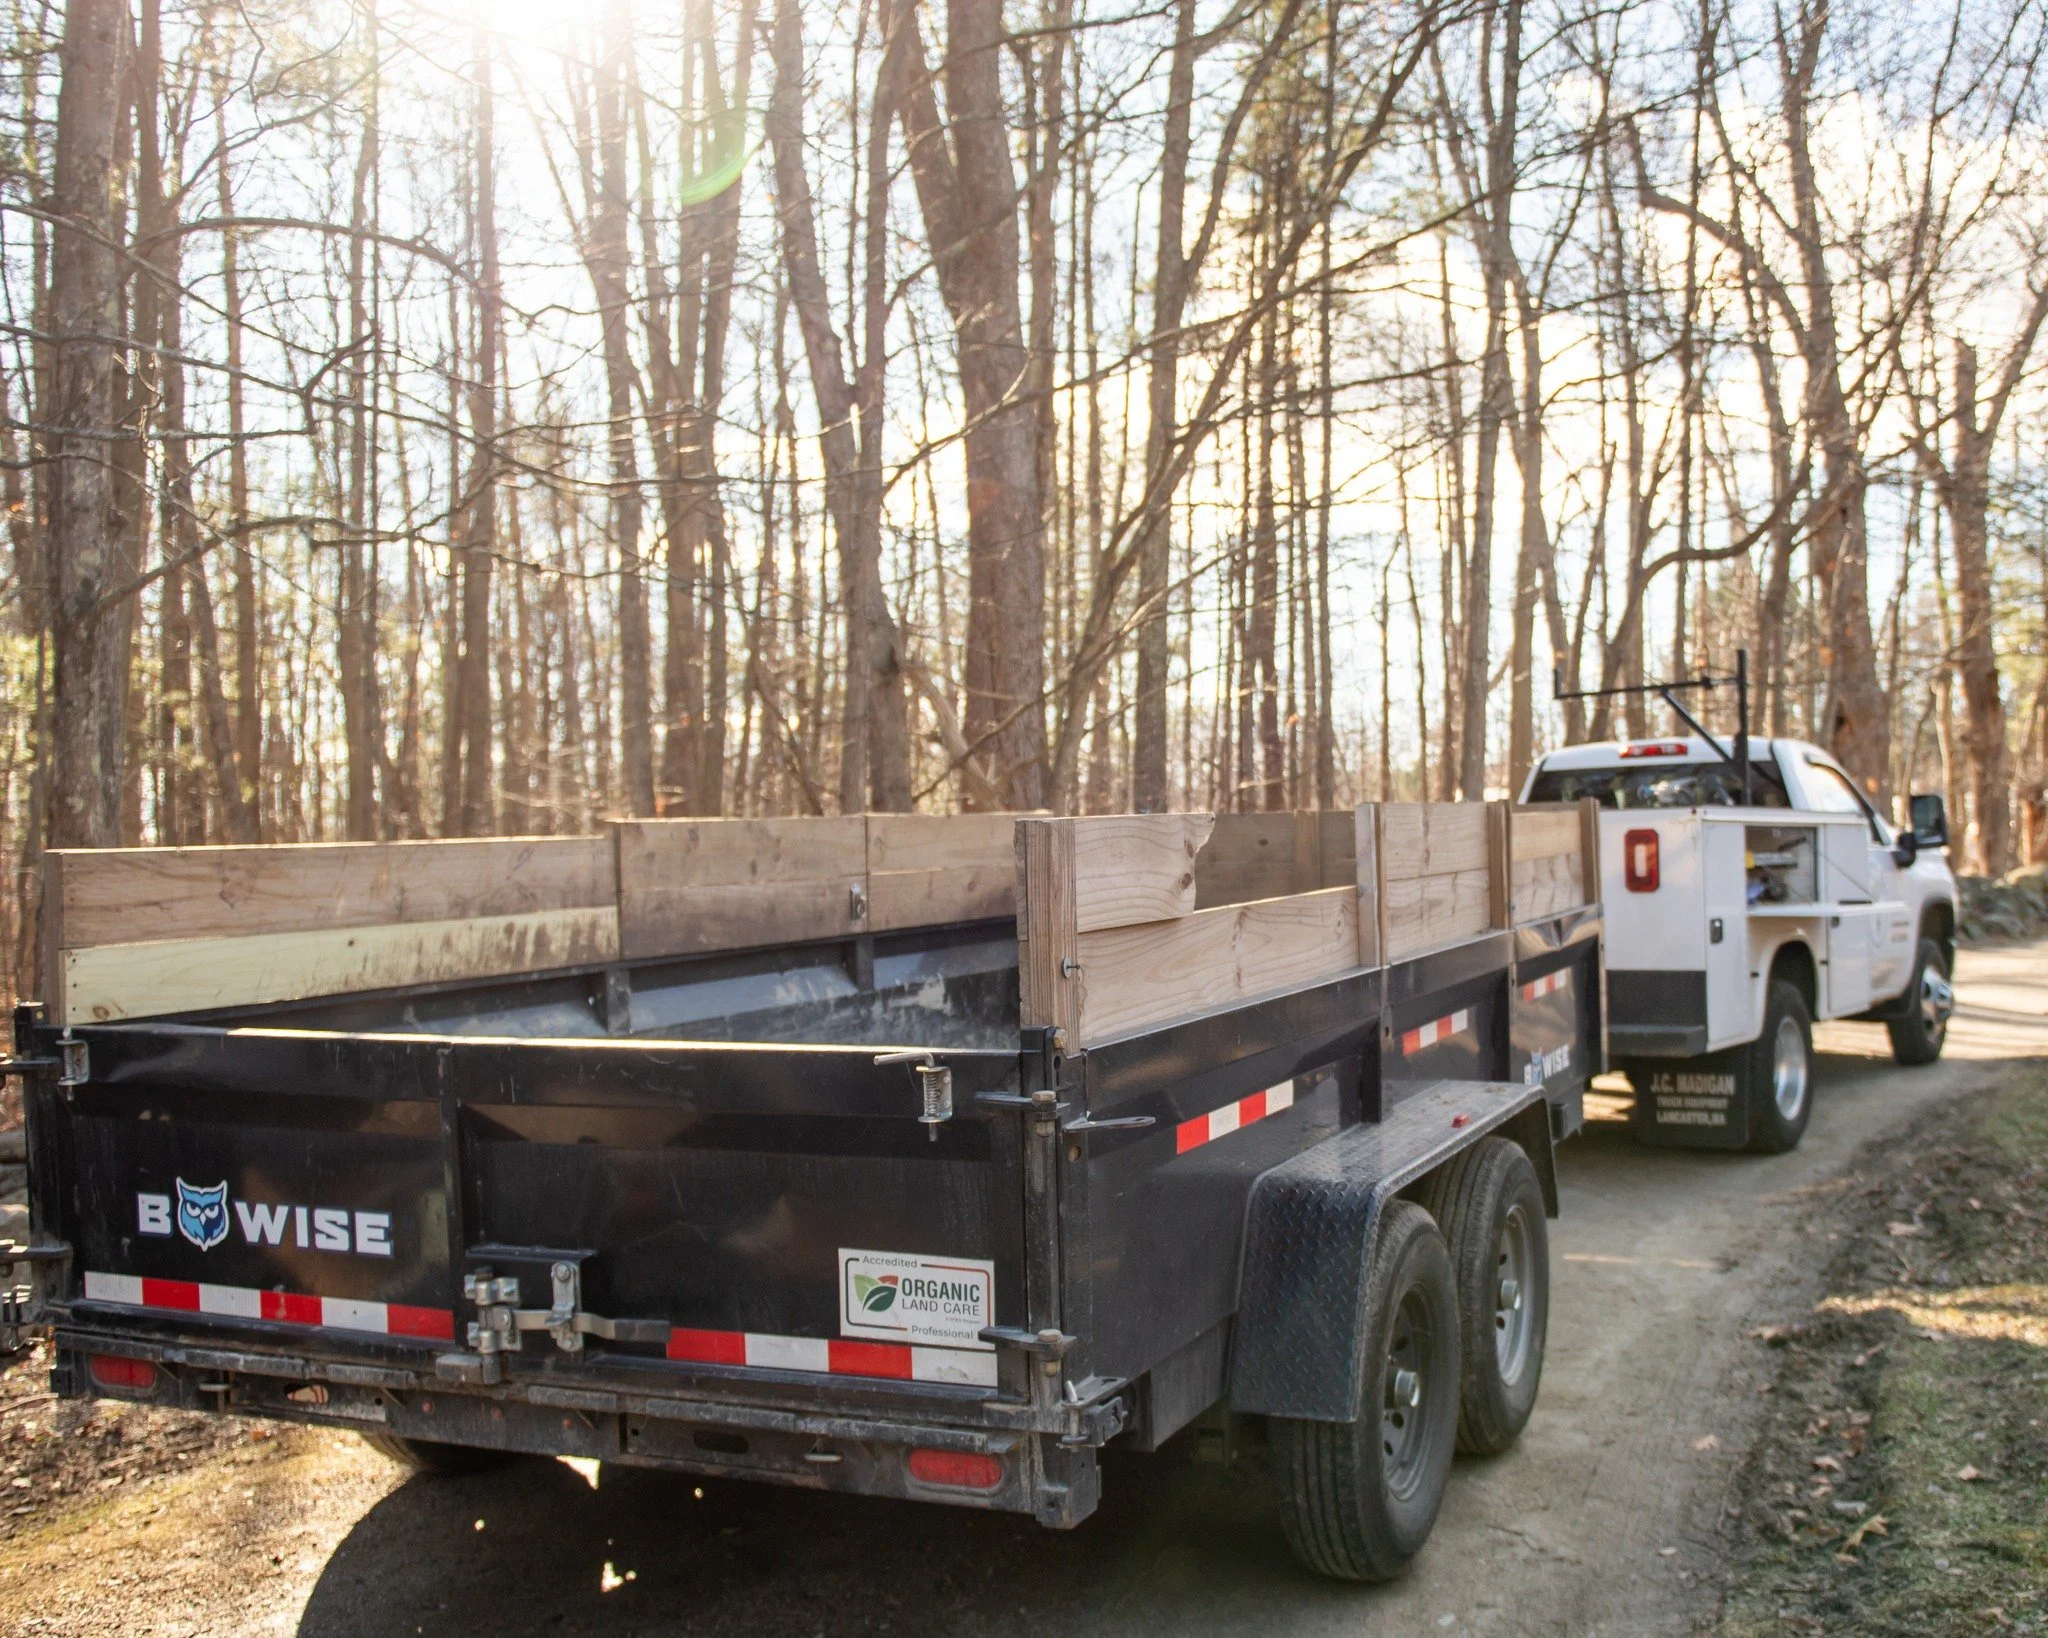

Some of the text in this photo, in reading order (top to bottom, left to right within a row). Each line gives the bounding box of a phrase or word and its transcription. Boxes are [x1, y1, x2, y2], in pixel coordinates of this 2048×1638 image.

[1541, 1043, 1570, 1079] WISE
[1676, 1073, 1735, 1096] MADIGAN
[234, 1200, 393, 1256] WISE
[862, 1255, 918, 1268] Accredited
[901, 1277, 980, 1303] ORGANIC
[902, 1298, 980, 1316] LAND CARE
[911, 1325, 973, 1339] Professional
